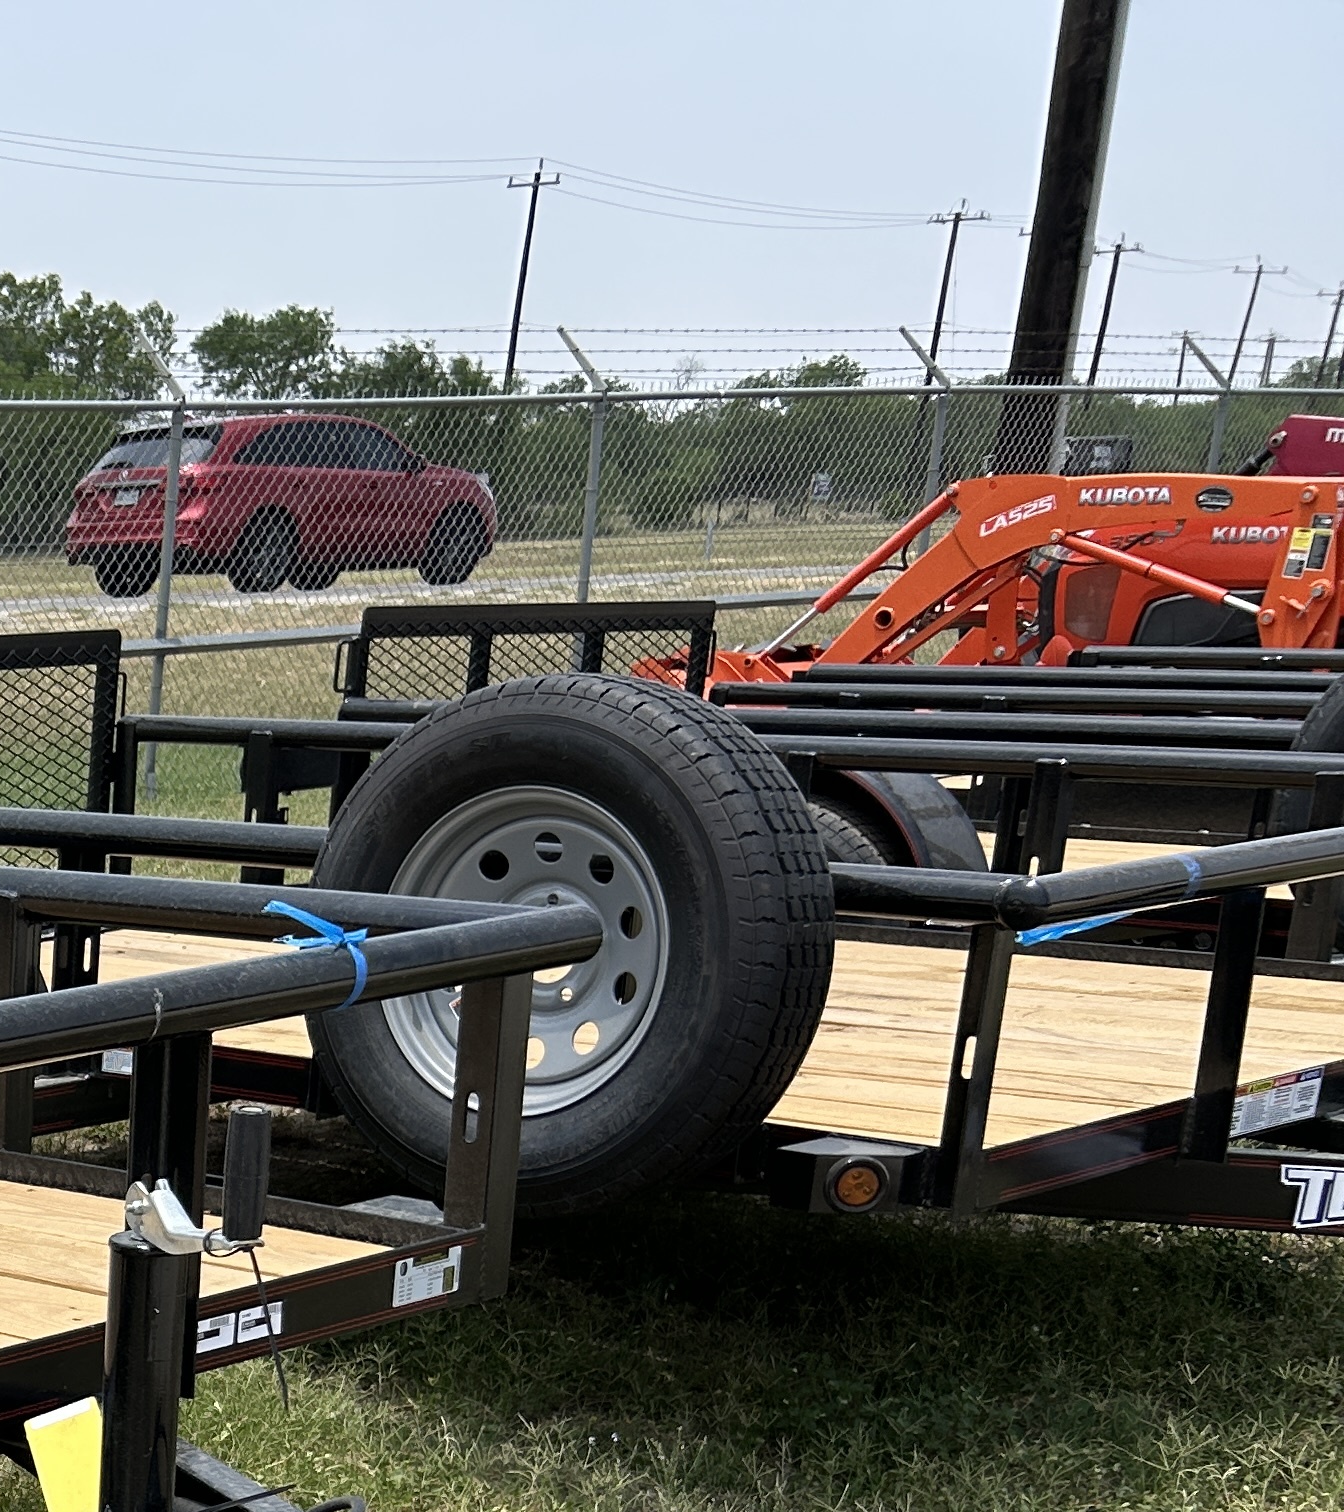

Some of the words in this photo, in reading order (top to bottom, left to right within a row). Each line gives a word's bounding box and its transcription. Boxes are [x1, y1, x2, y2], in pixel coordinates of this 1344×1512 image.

[1078, 486, 1172, 506] KUBOTA
[979, 494, 1057, 538] LA525
[1211, 525, 1289, 544] KUBOT
